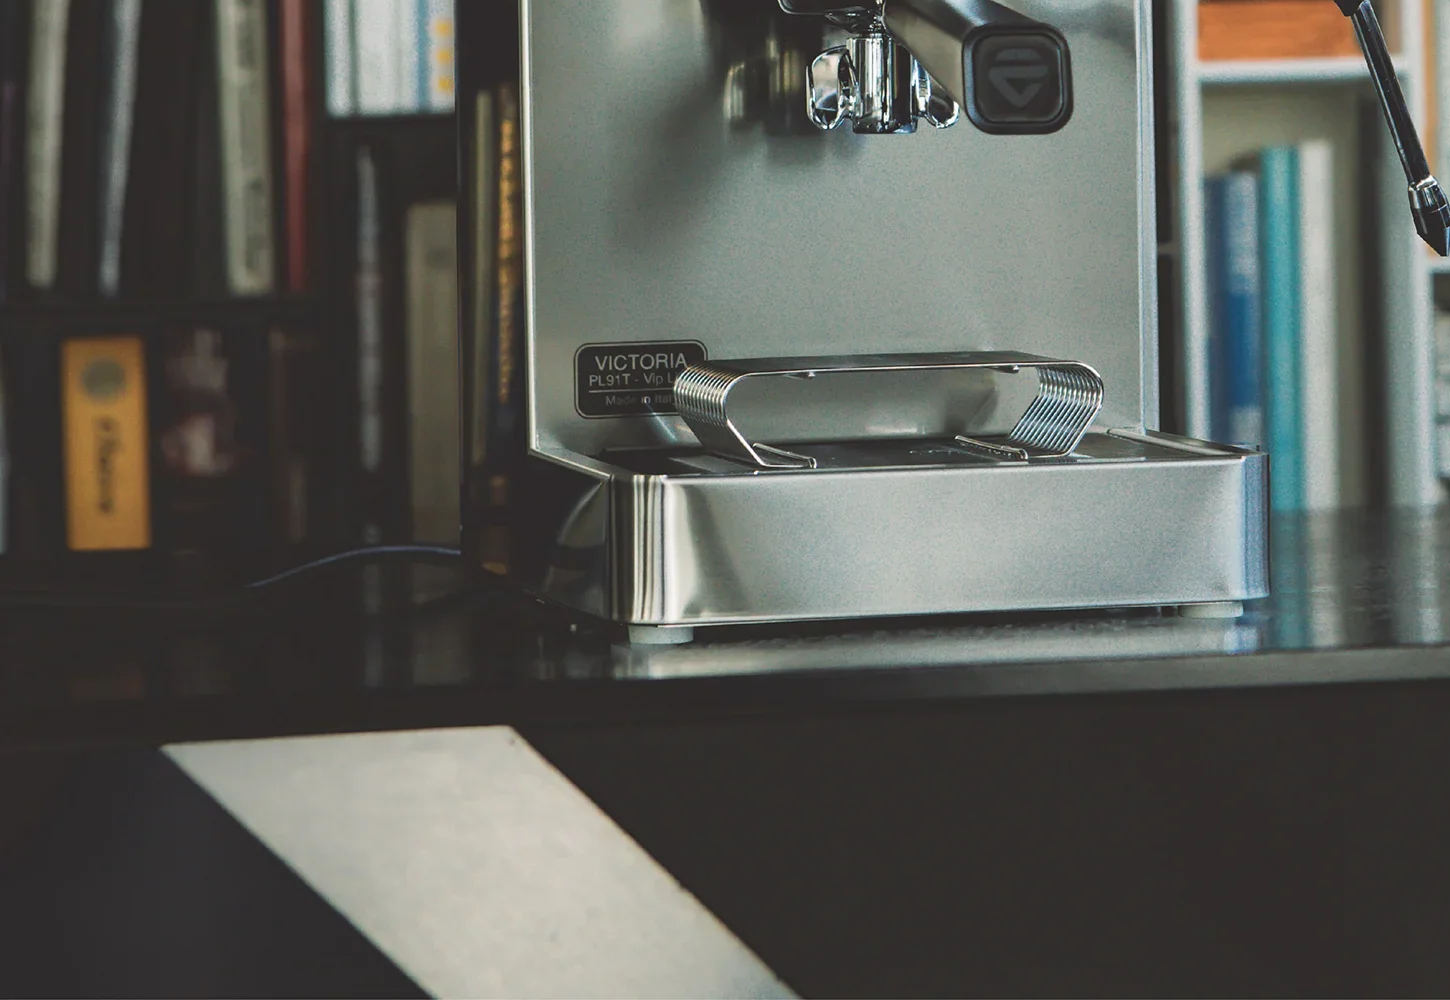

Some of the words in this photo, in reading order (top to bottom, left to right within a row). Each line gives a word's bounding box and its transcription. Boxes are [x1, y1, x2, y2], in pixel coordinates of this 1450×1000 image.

[595, 353, 688, 371] VICTORIA
[589, 373, 631, 387] PL91T
[643, 372, 664, 387] Vip
[641, 395, 651, 404] in
[654, 394, 676, 406] Ital
